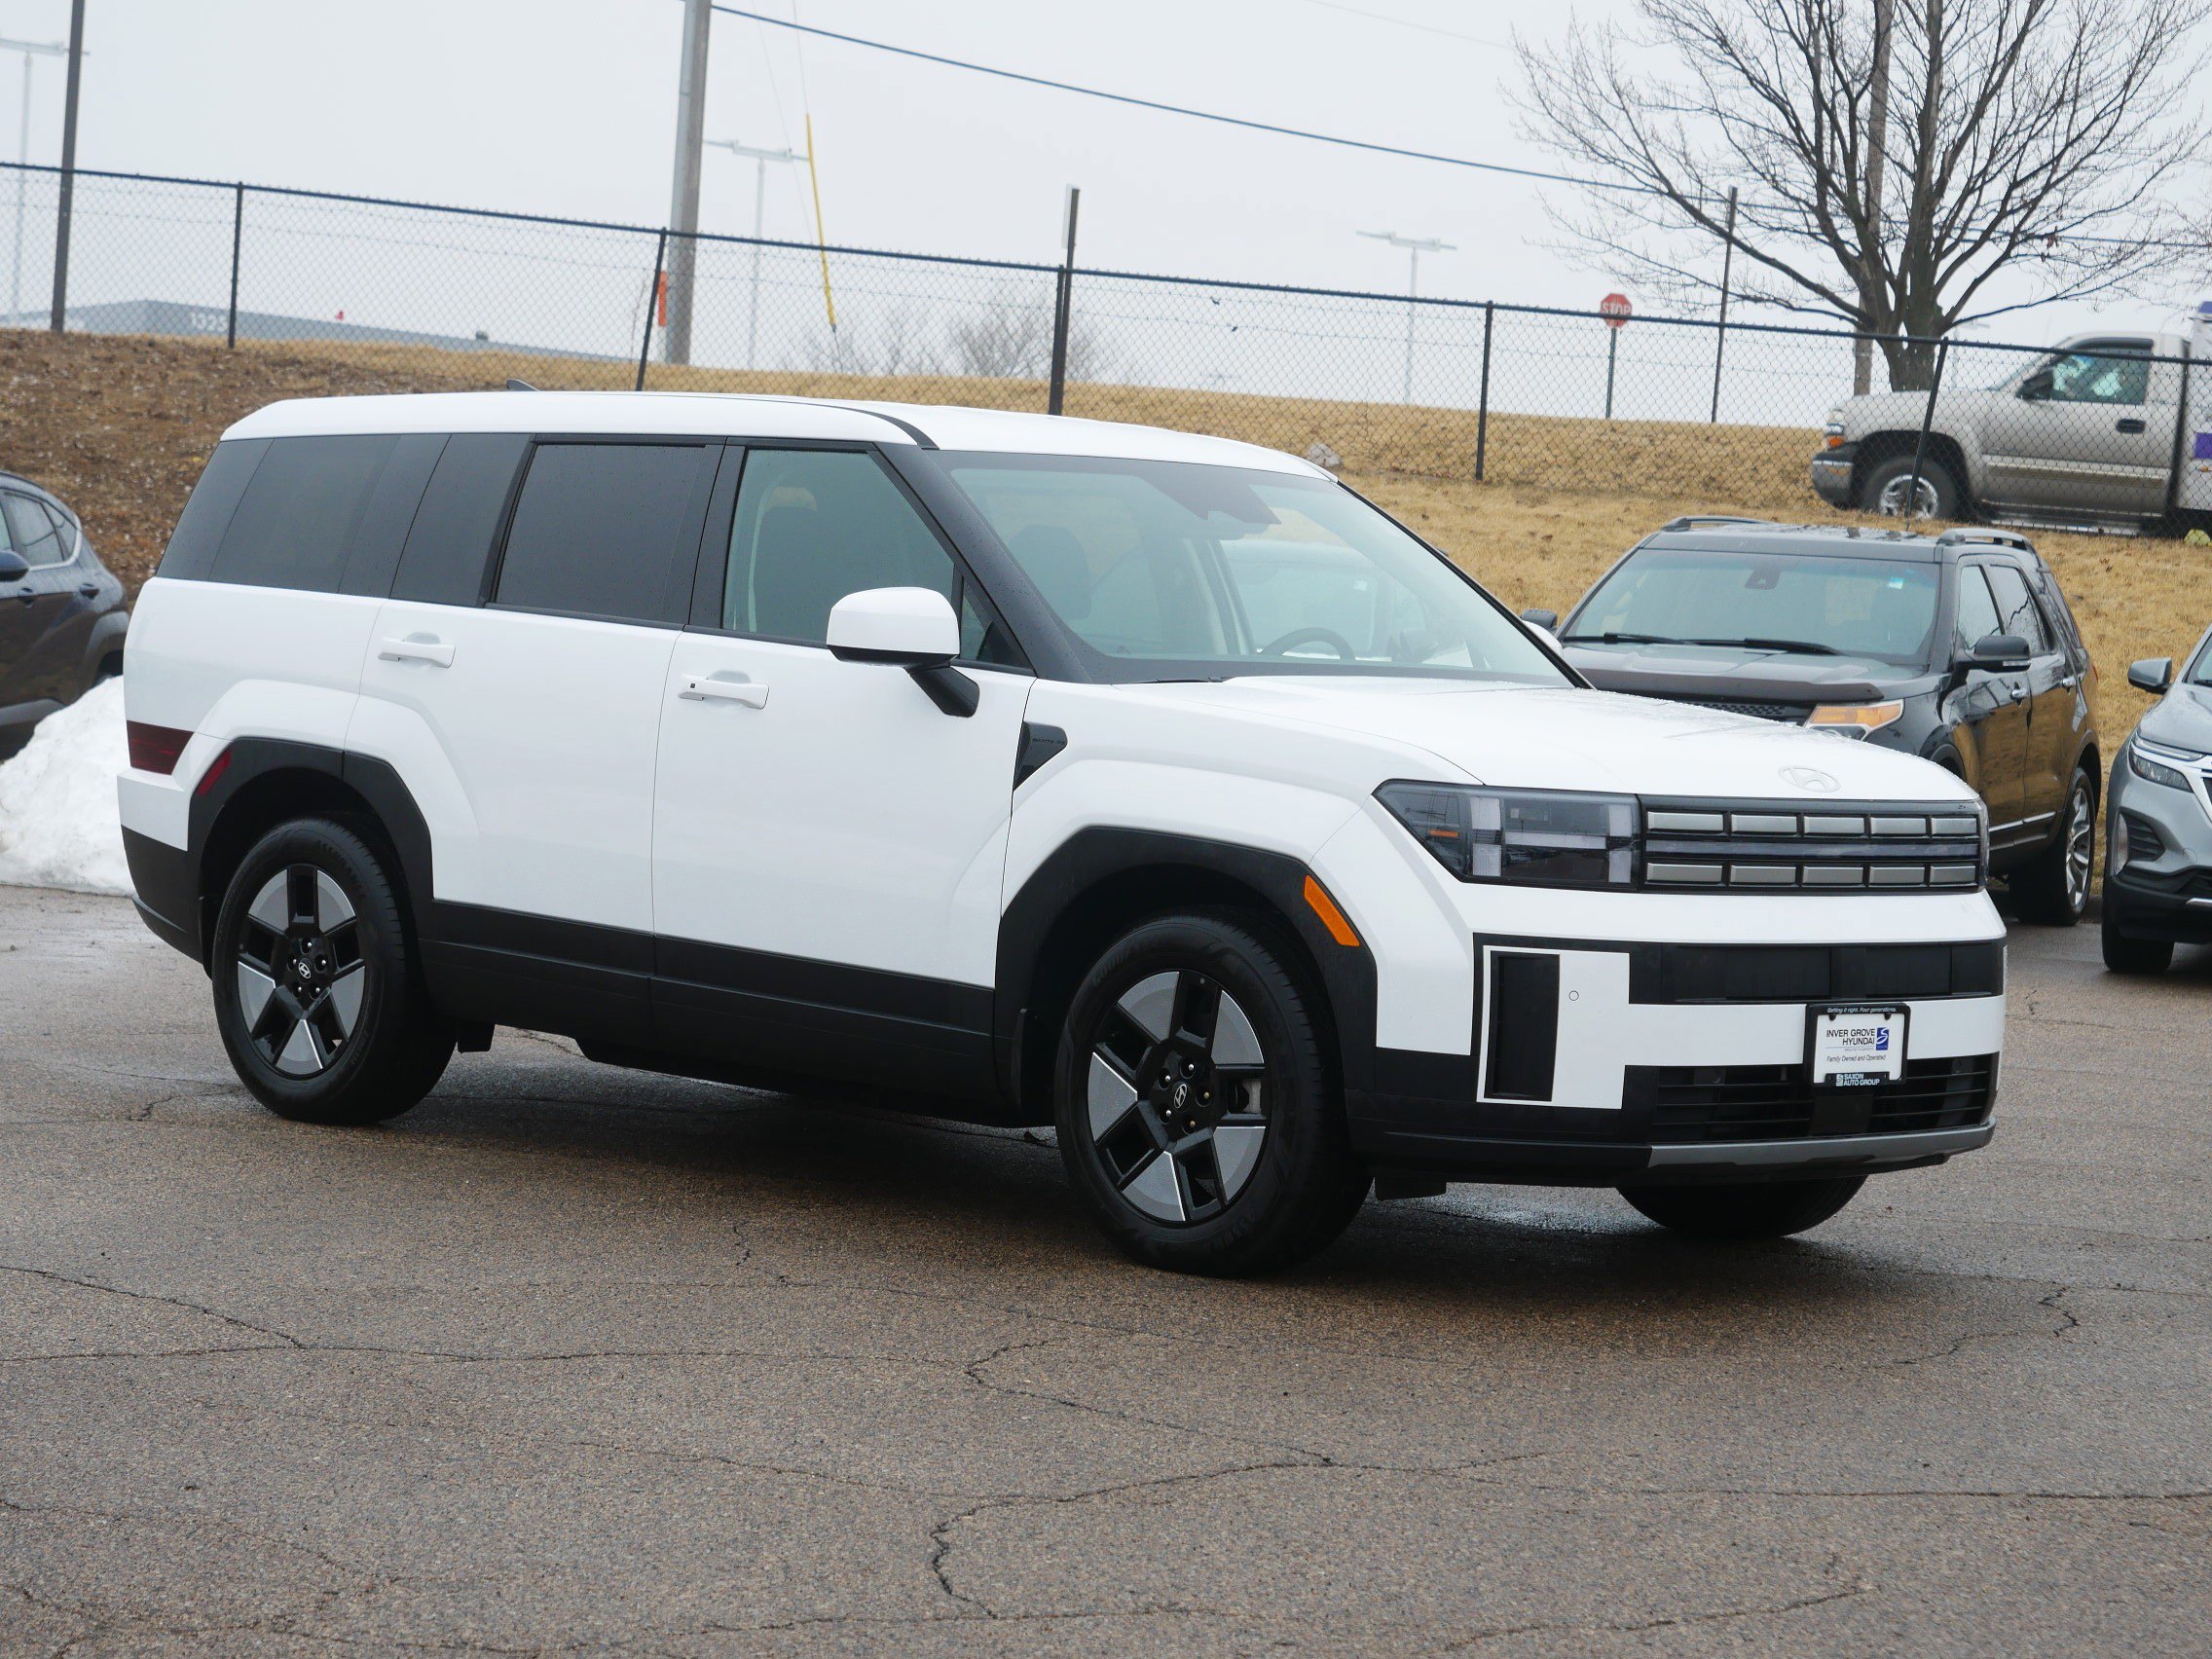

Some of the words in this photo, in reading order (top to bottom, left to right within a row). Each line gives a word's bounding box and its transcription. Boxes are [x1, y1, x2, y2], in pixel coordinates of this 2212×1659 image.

[1601, 302, 1632, 315] STOP
[1826, 1029, 1849, 1038] INVER
[1851, 1028, 1875, 1037] GROVE
[1842, 1037, 1875, 1046] HYUNDAI
